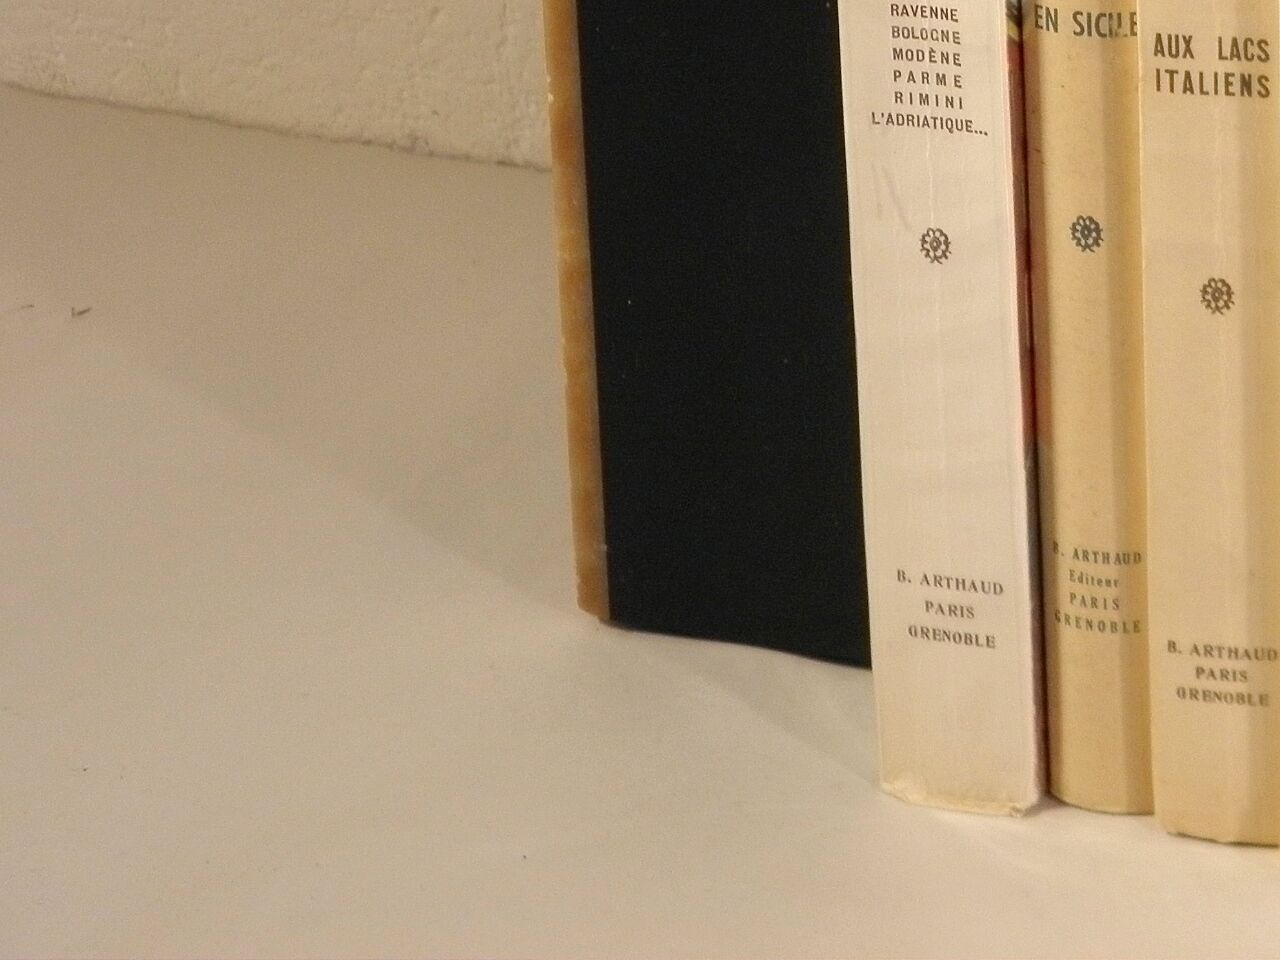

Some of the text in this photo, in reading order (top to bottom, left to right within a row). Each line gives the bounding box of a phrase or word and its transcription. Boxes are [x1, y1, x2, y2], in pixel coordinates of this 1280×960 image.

[890, 3, 959, 24] RAVENNE
[1034, 3, 1059, 34] EN
[891, 25, 961, 45] BOLOGNE
[892, 47, 962, 67] MODÈNE
[1153, 32, 1270, 64] AUX LACS
[893, 69, 962, 89] PARME
[1155, 69, 1271, 100] ITALIENS
[894, 91, 964, 111] RIMINI
[1053, 540, 1142, 566] B. ARTHAUD
[897, 569, 1005, 596] B. ARTHAUD
[924, 600, 976, 620] PARIS
[1069, 591, 1120, 612] PARIS
[1054, 608, 1142, 635] GRENOBLE
[908, 624, 997, 649] GRENOBLE
[1166, 640, 1279, 663] B. ARTHAUD
[1195, 666, 1249, 684] PARIS
[1176, 686, 1271, 708] GRENOBLE
